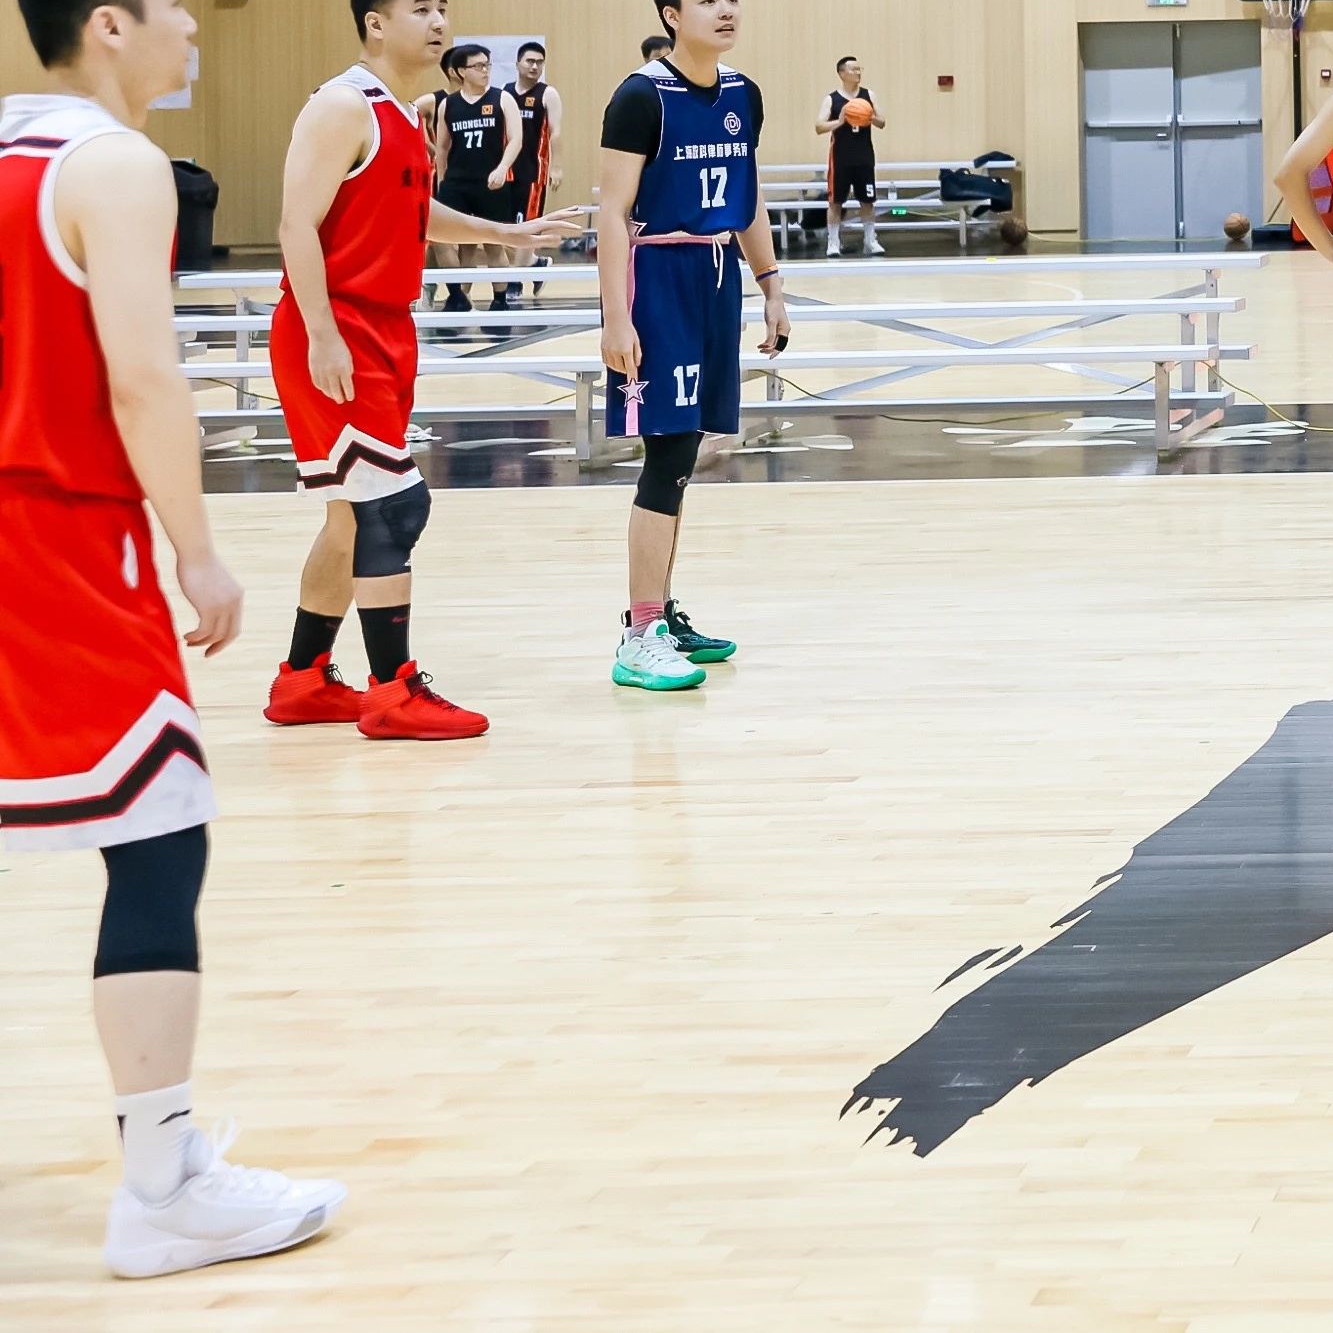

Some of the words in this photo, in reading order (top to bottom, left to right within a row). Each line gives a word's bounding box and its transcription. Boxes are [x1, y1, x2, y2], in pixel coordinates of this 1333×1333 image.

[464, 130, 484, 149] 77
[699, 167, 728, 209] 17
[673, 364, 701, 407] 17
